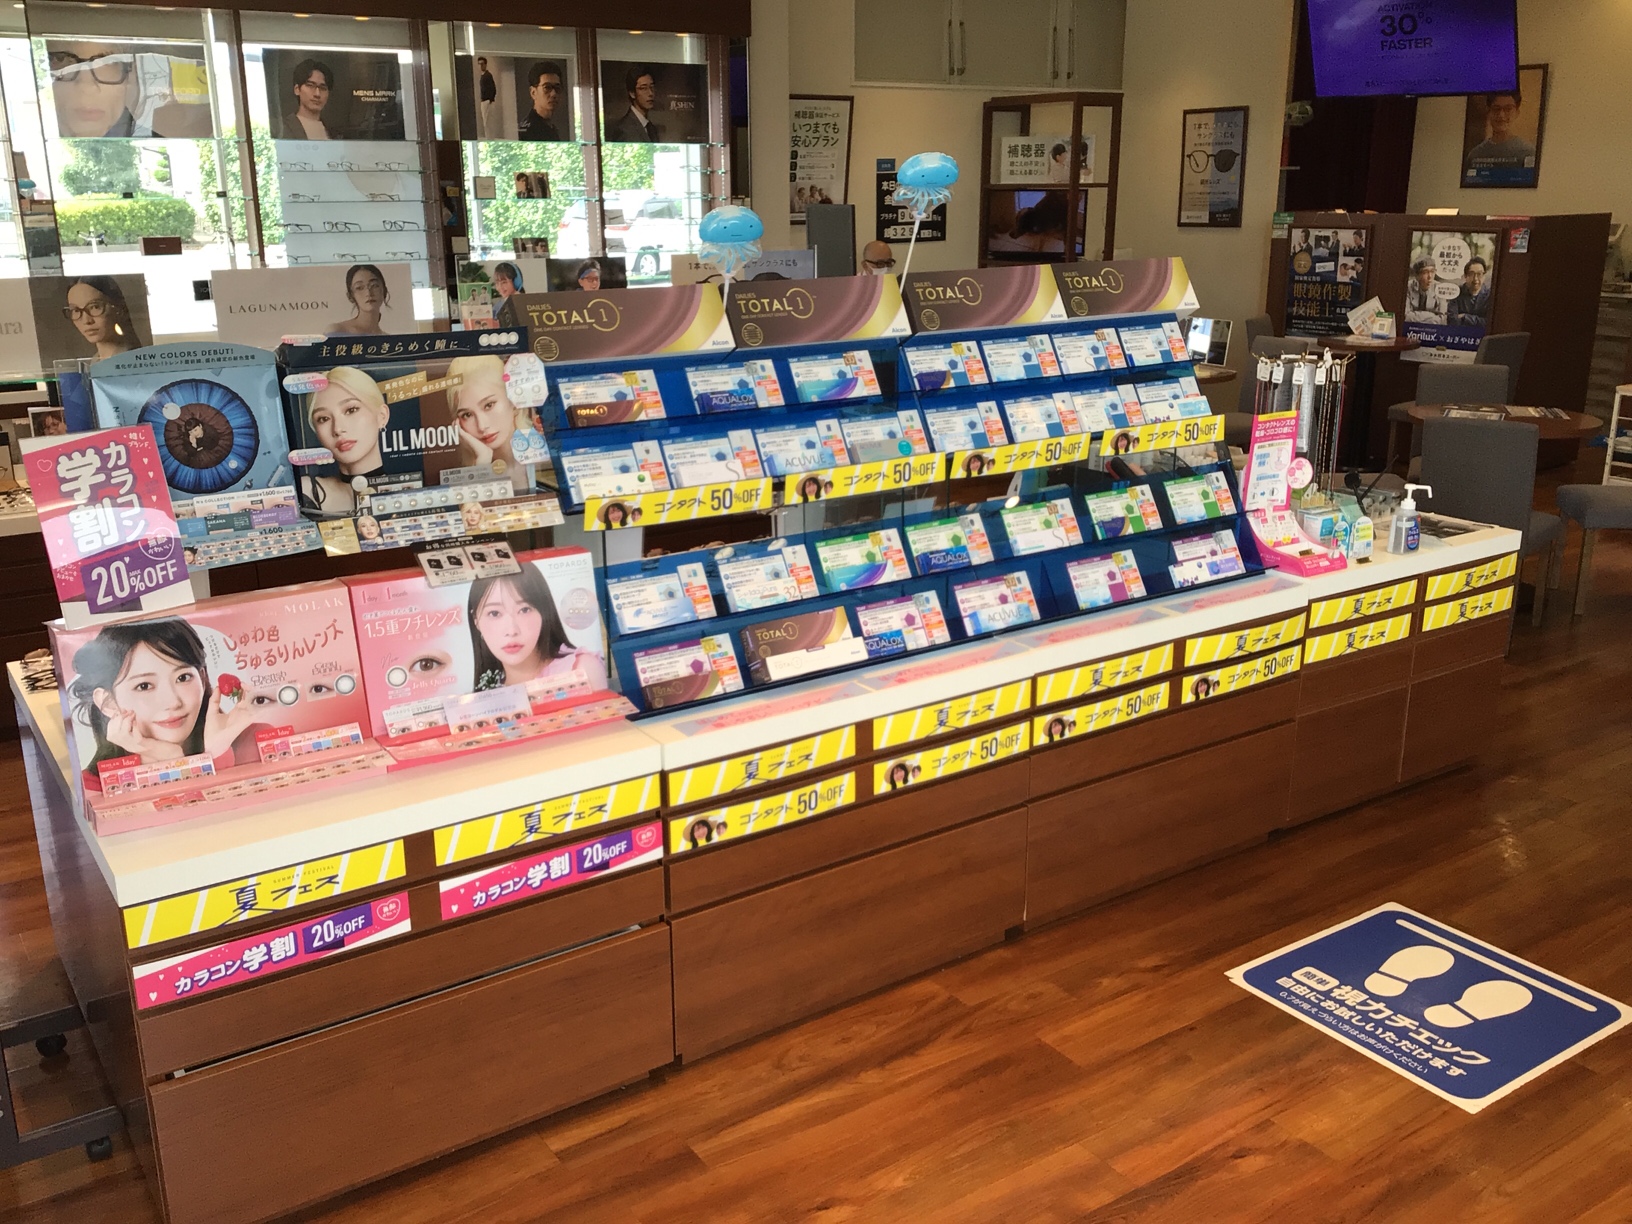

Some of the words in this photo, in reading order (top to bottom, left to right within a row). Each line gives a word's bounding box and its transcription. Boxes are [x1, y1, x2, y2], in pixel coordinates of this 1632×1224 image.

[1380, 37, 1433, 51] FASTER
[792, 121, 840, 134] いつまでも
[791, 135, 840, 148] 安心プラン
[1007, 143, 1046, 158] 補聴器
[915, 285, 964, 301] TOTAL
[1065, 275, 1107, 289] TOTAL
[228, 300, 330, 315] LAGUNAMOON
[526, 303, 552, 311] DAILIES
[737, 297, 794, 314] TOTAL
[529, 309, 595, 327] TOTAL
[135, 353, 156, 361] NEW
[160, 350, 198, 359] COLORS
[201, 348, 234, 357] DEBUT!
[381, 429, 409, 453] LIL
[409, 424, 460, 450] MOON
[1146, 430, 1182, 443] コンタクト
[784, 452, 827, 468] ACUVUE
[1003, 450, 1043, 464] コンタクト
[1044, 441, 1083, 462] 50%OFF
[843, 471, 890, 487] コンタクト
[892, 461, 937, 485] 50%OFF
[56, 447, 120, 553] 学割
[102, 441, 146, 543] カラコン
[654, 497, 707, 515] コンタクト
[710, 487, 762, 511] 50%OFF
[547, 558, 588, 570] TOPARDS
[1455, 570, 1498, 594] 夏フェス
[284, 597, 344, 614] MOLAK
[987, 607, 1024, 623] ACUVUE
[1344, 597, 1393, 622] 夏フェス
[1452, 601, 1493, 625] 夏フェス
[364, 607, 461, 639] 1.5重フチレンズ
[223, 624, 281, 652] じゅわ色
[234, 618, 344, 671] ちゅるりんレンズ
[756, 629, 787, 642] TOTAL
[1226, 633, 1282, 659] 夏フェス
[1337, 630, 1387, 656] 夏フェス
[1081, 665, 1143, 696] 夏フェス
[1228, 668, 1262, 684] コンタクト
[1085, 706, 1124, 725] コンタクト
[1126, 691, 1162, 717] 50%OFF
[924, 704, 995, 738] 夏フェス
[931, 749, 978, 770] コンタクト
[980, 732, 1022, 760] 50%OFF
[728, 753, 814, 793] 夏フェス
[739, 804, 794, 827] コンタクト
[797, 784, 846, 815] 50%OFF
[508, 803, 609, 849] 夏フェス
[273, 873, 300, 884] SUMMER
[303, 865, 335, 876] FESTIVAL
[473, 852, 571, 908] カラコン学割
[582, 840, 628, 870] 20%OFF
[216, 873, 340, 928] 夏フェス
[174, 932, 296, 995] カラコン学割
[311, 914, 366, 949] 20%OFF
[1299, 969, 1332, 987] 簡単
[1275, 975, 1468, 1077] 自由にお試しいただけます
[1329, 984, 1492, 1065] 視力チェック
